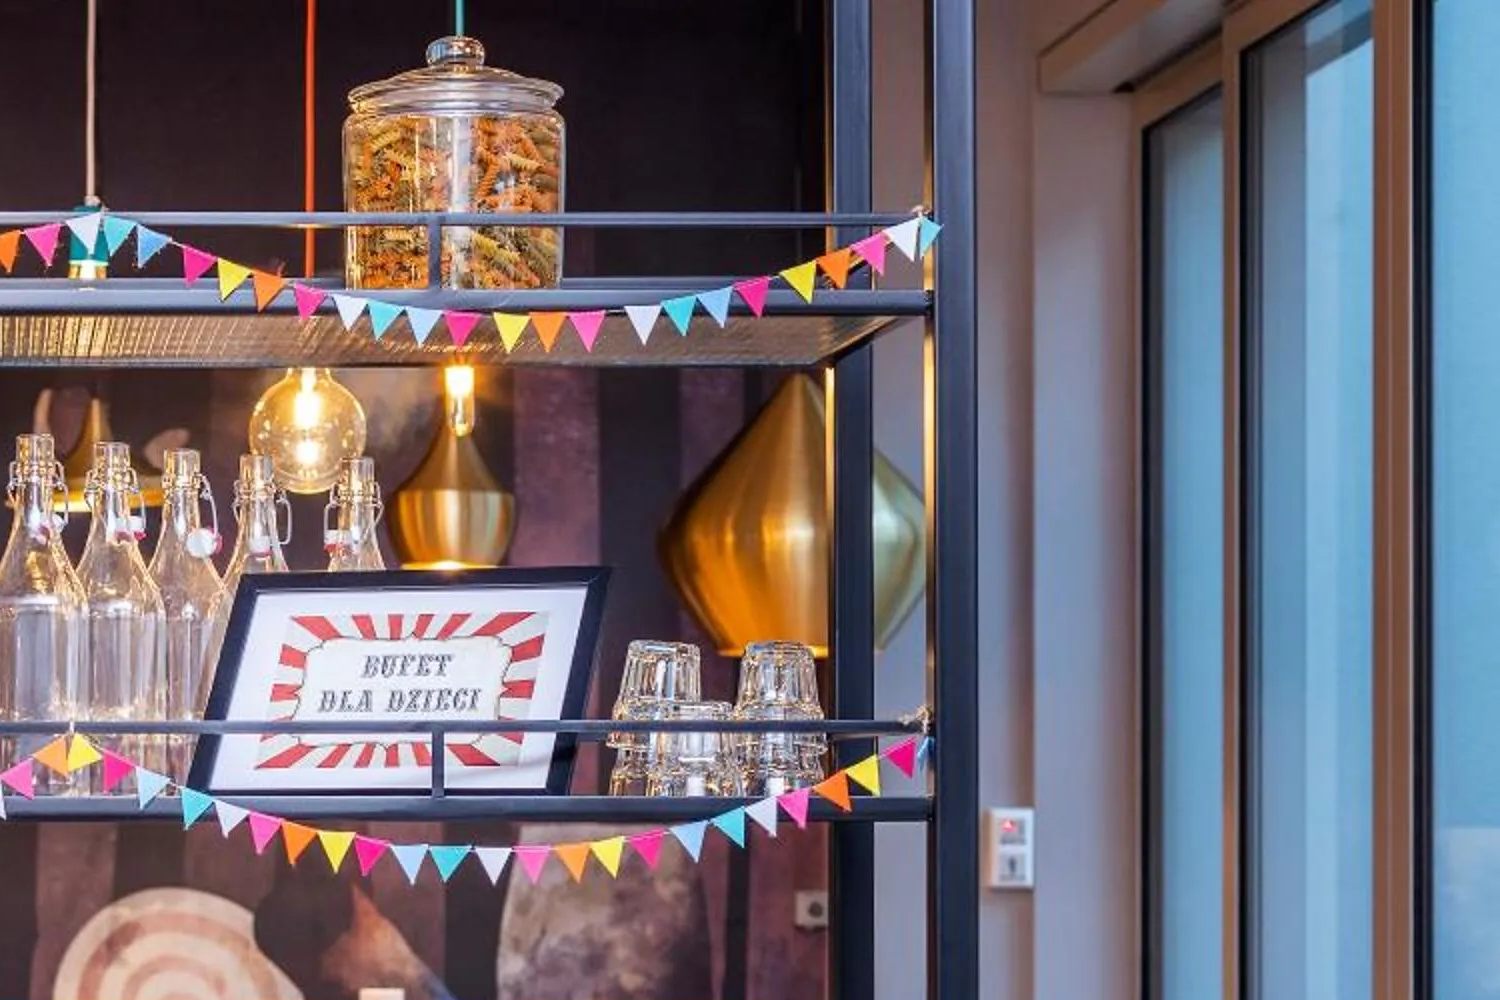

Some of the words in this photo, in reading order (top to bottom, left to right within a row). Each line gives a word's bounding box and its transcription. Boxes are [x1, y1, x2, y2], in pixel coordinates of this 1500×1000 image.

[361, 653, 454, 678] BUFET
[318, 689, 373, 712] DLA
[385, 687, 482, 712] DZIECI
